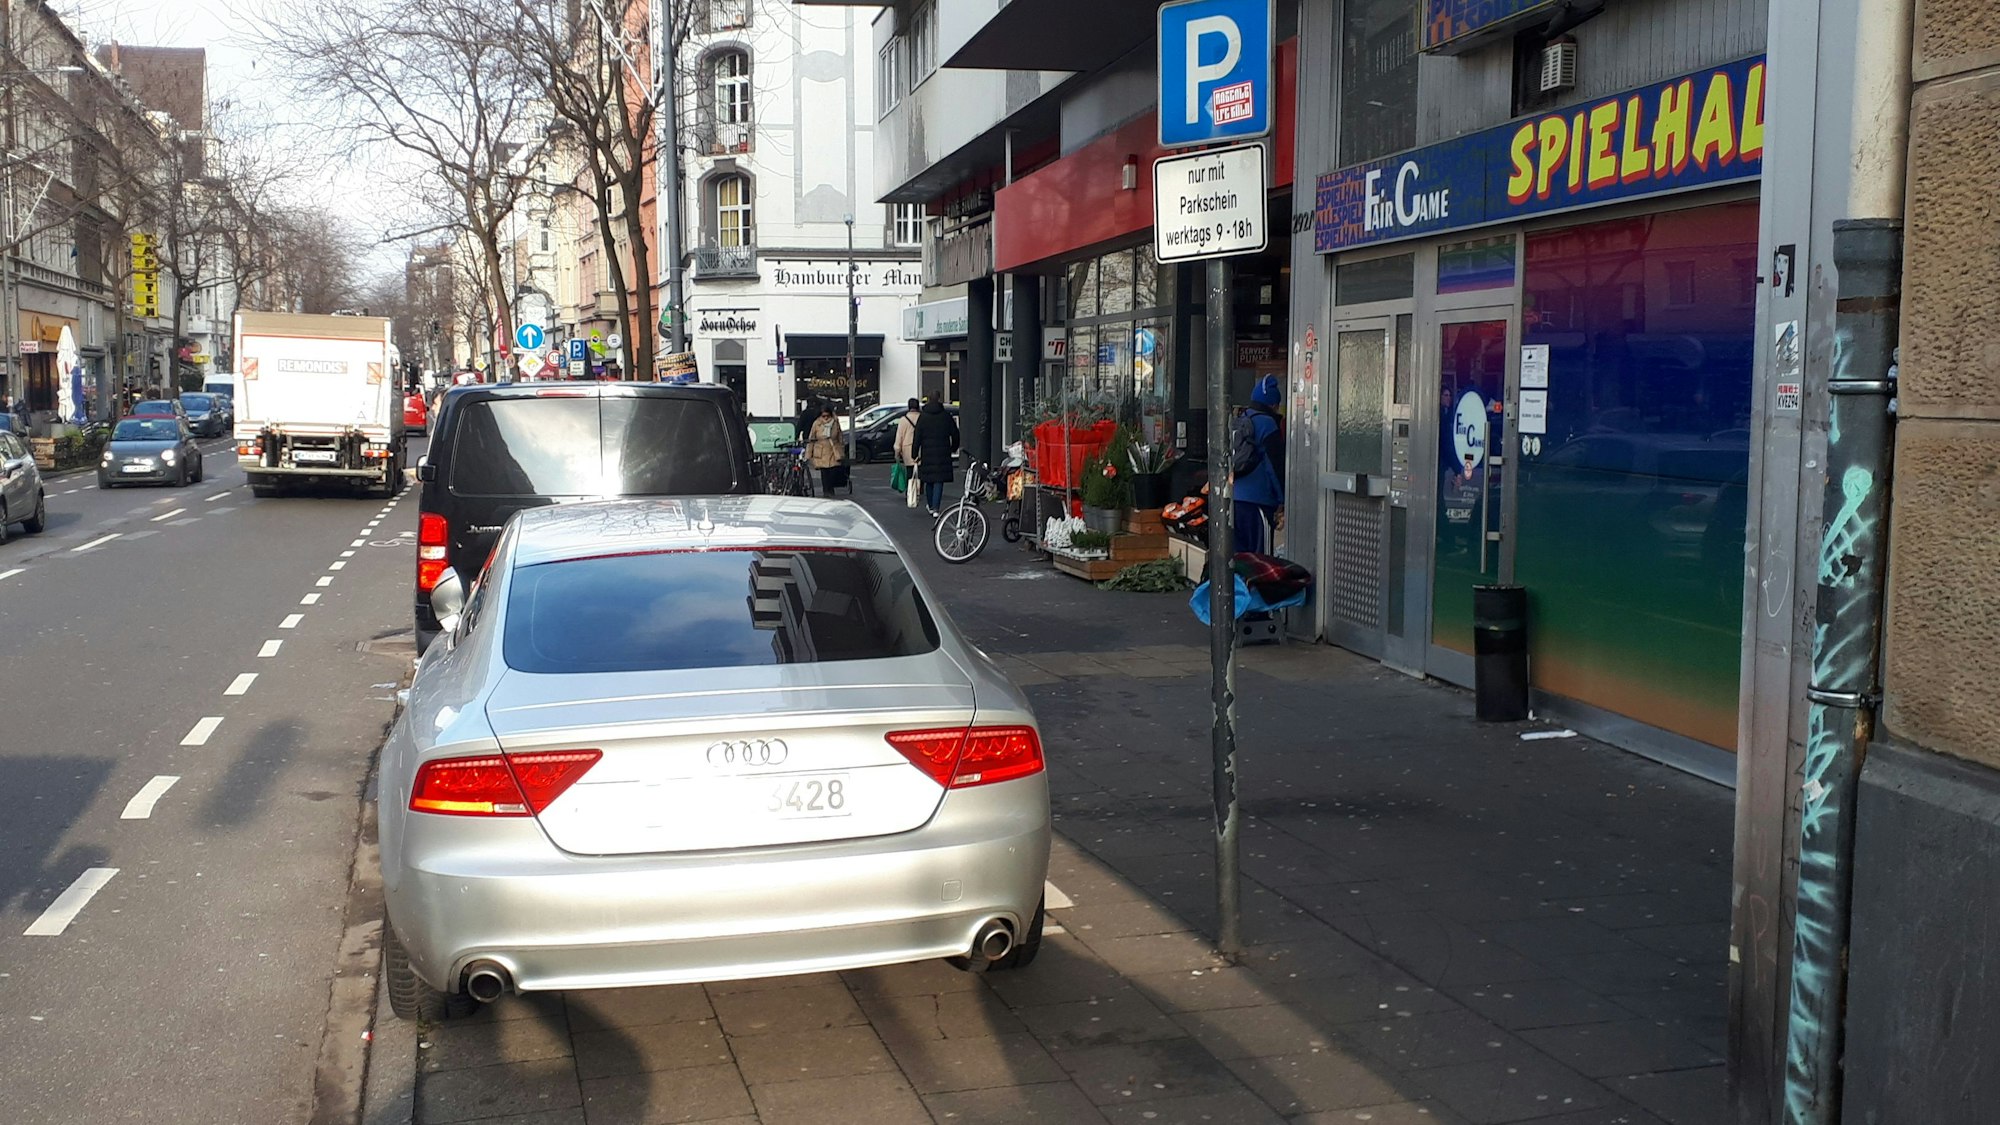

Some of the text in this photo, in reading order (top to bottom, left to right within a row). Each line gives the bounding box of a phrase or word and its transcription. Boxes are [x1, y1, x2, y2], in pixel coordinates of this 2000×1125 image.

[1186, 15, 1242, 124] P
[1508, 63, 1765, 203] SPIELHAL
[1188, 161, 1225, 184] nur mit
[1180, 190, 1237, 215] Parkschein
[1166, 225, 1211, 247] werktags
[143, 234, 155, 316] TAPETEN
[774, 268, 871, 288] Hamburger
[698, 317, 757, 335] HornOchse
[278, 359, 342, 374] REMONDIS
